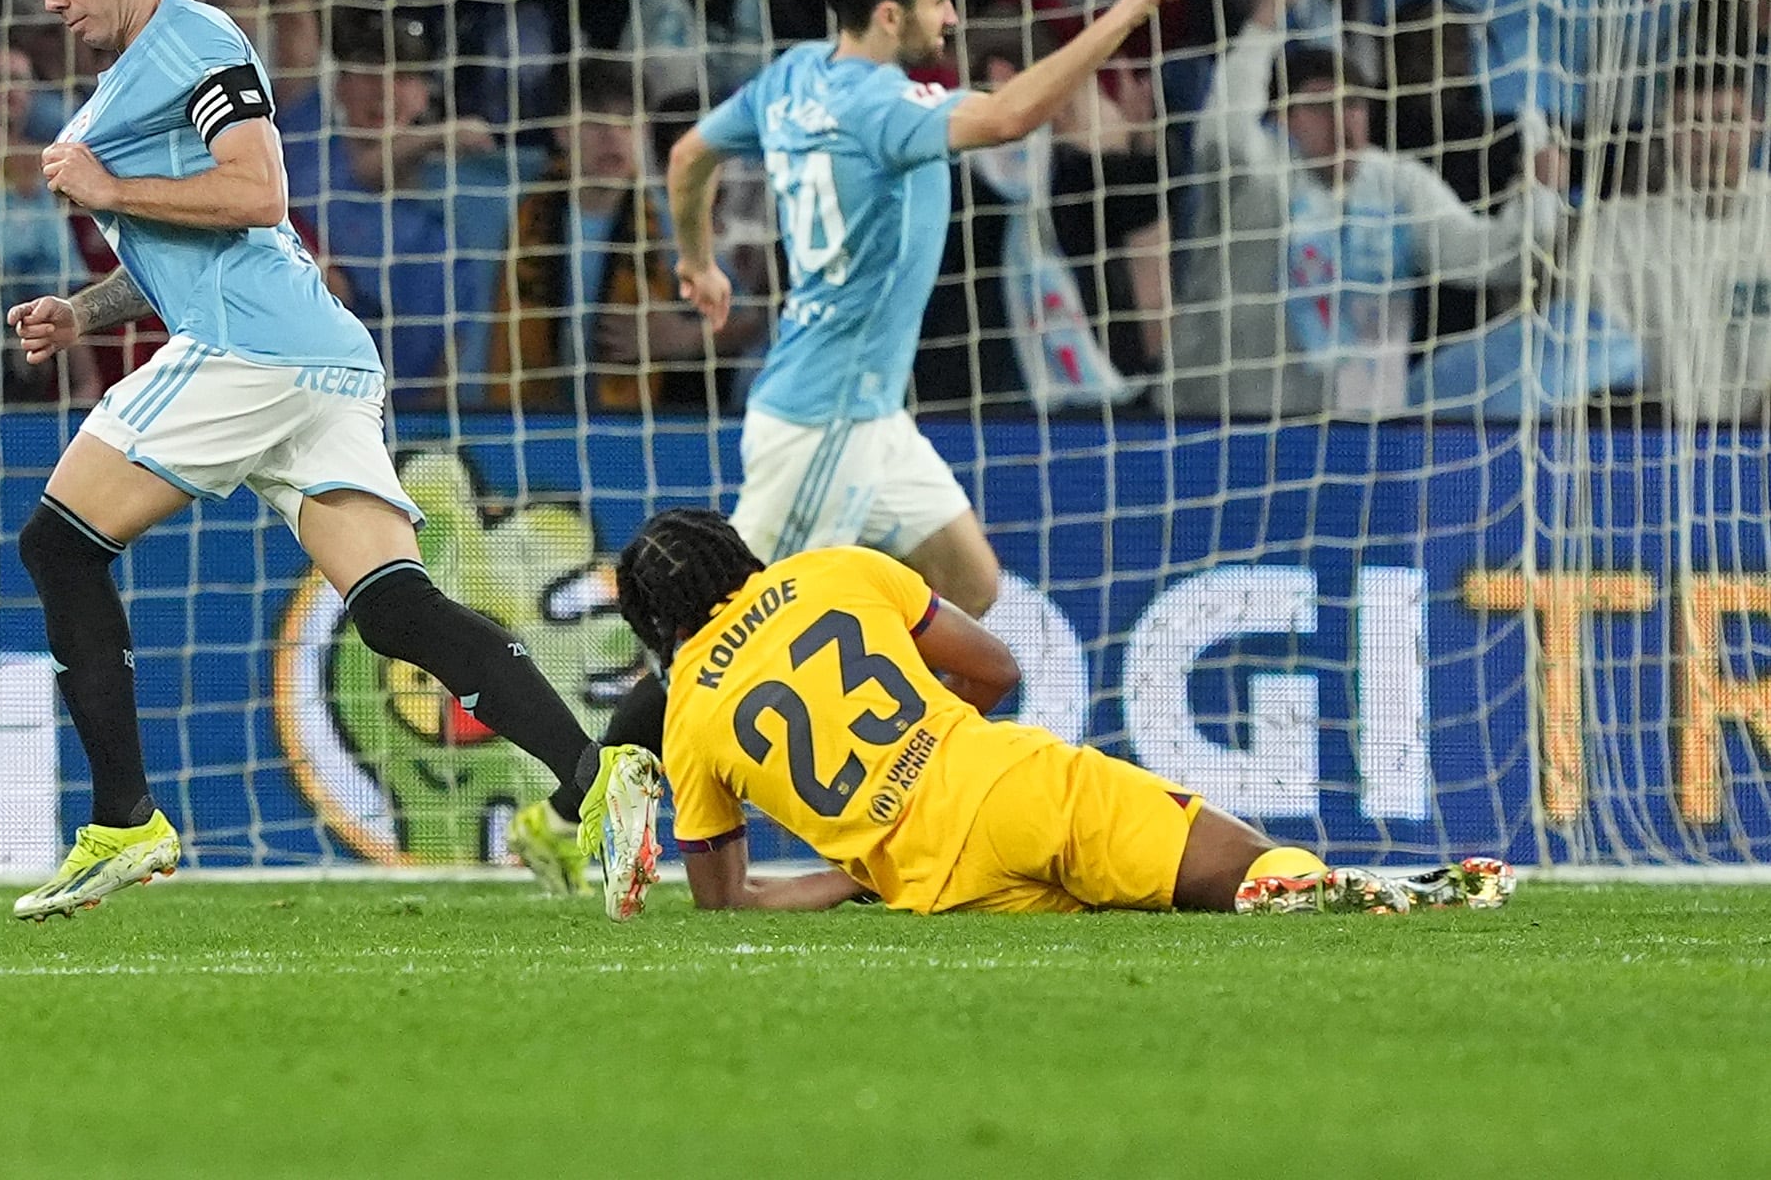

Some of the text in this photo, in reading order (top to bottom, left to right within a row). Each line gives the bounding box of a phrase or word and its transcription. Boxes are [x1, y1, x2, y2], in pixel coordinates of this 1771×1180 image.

[696, 578, 798, 690] KOUNDE
[733, 609, 927, 818] 23
[886, 728, 930, 782] UNHCR
[900, 735, 939, 791] ACNUR
